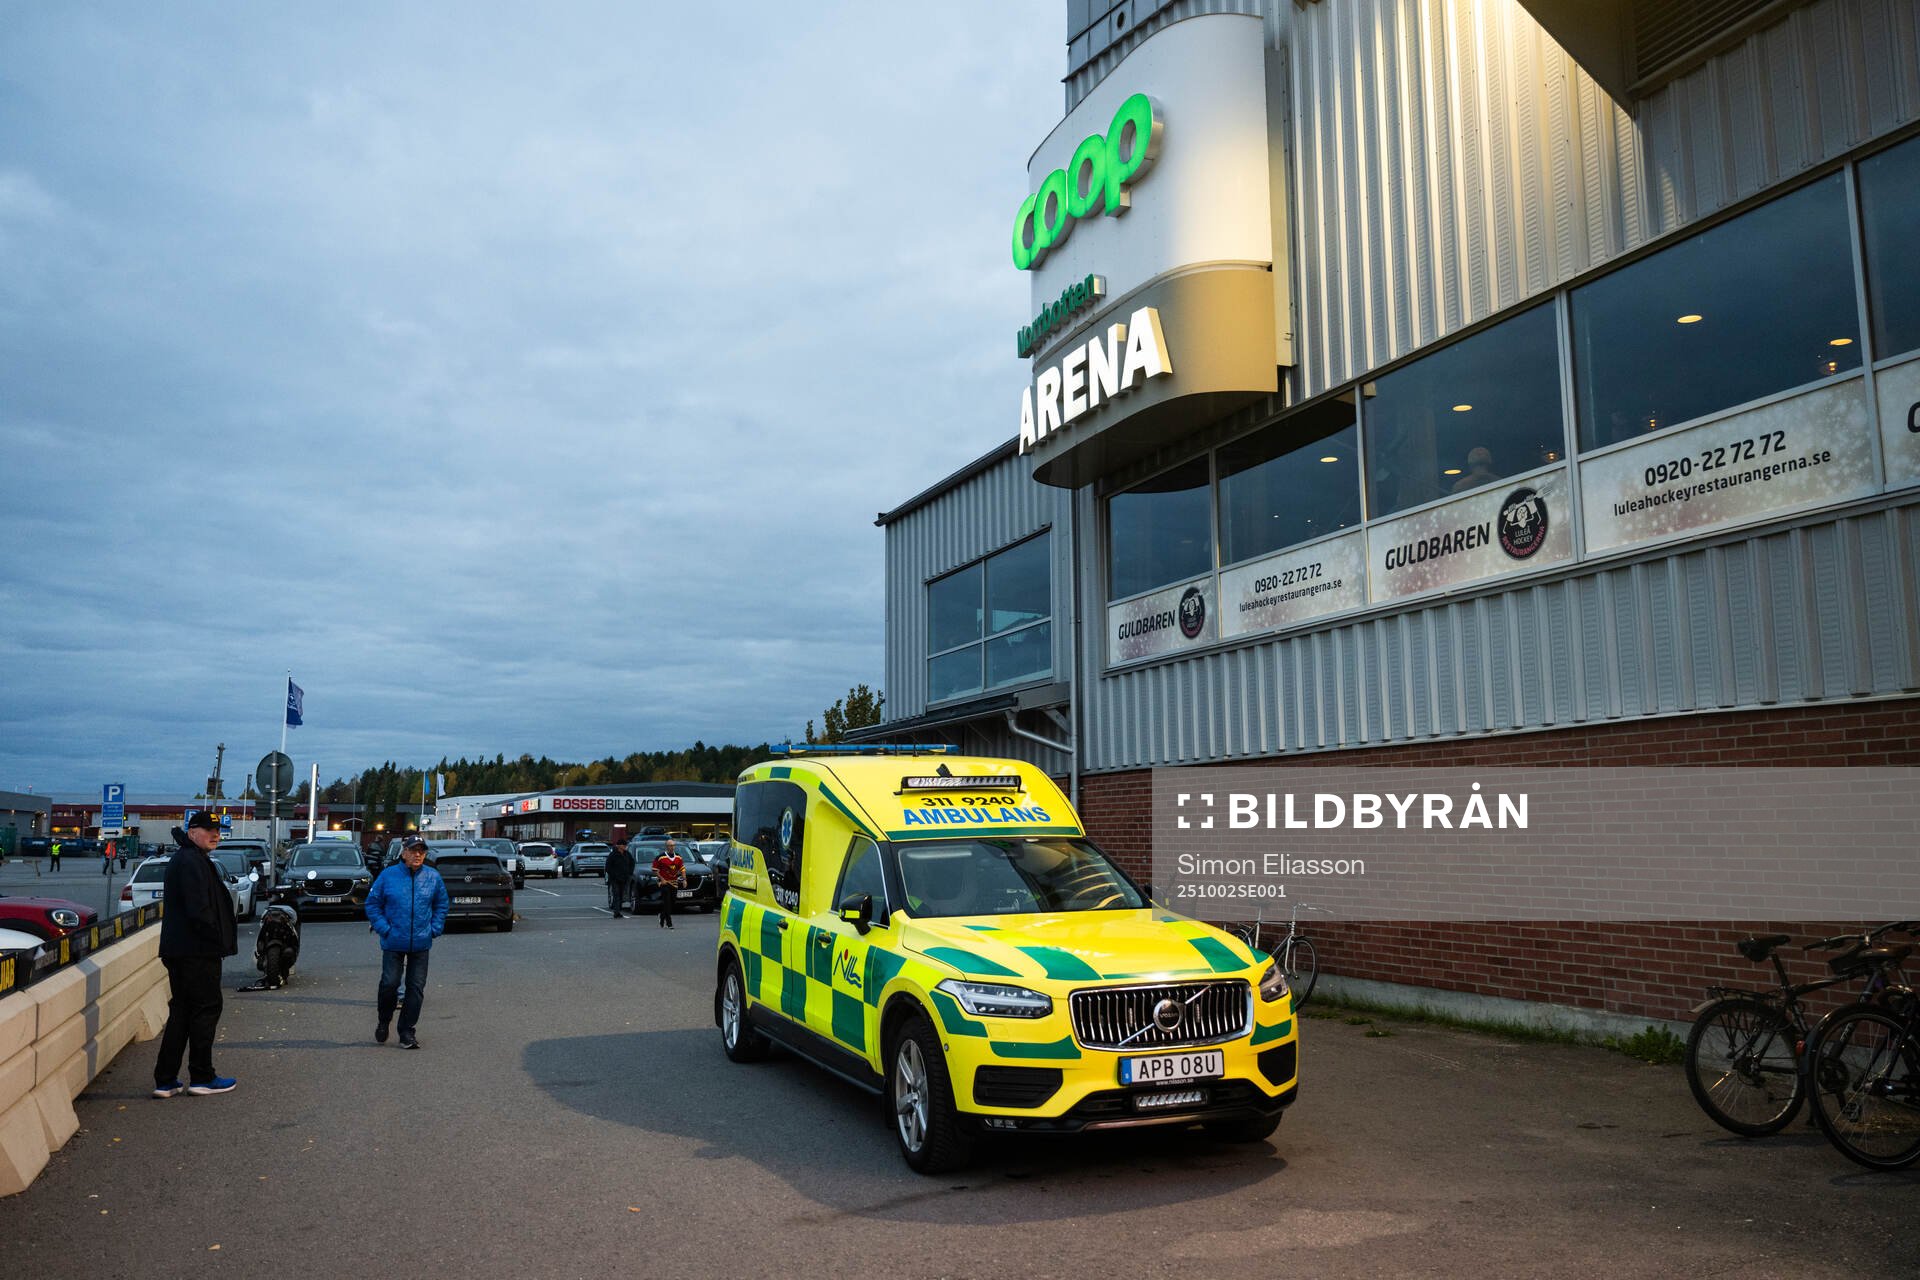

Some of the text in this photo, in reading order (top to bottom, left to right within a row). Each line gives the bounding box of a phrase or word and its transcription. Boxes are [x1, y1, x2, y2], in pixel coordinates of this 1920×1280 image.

[1012, 93, 1153, 270] coop
[1017, 273, 1095, 357] Norrbotten
[1018, 306, 1165, 456] ARENA
[1645, 430, 1786, 487] 0920-22 72 72
[1614, 450, 1831, 516] luleahockeyrestaurangerna.se
[1385, 522, 1491, 570] GULDBAREN
[1513, 535, 1533, 545] HOCKEY
[1254, 562, 1322, 593] 0920-22 72 72
[1239, 578, 1342, 613] luleahockeyrestaurangerna.se
[1118, 609, 1176, 640] GULDBAREN
[108, 785, 121, 802] P
[921, 796, 1015, 806] 311 9240
[903, 806, 1051, 825] AMBULANS
[785, 889, 799, 906] 9240
[1139, 1054, 1216, 1080] APB 08U
